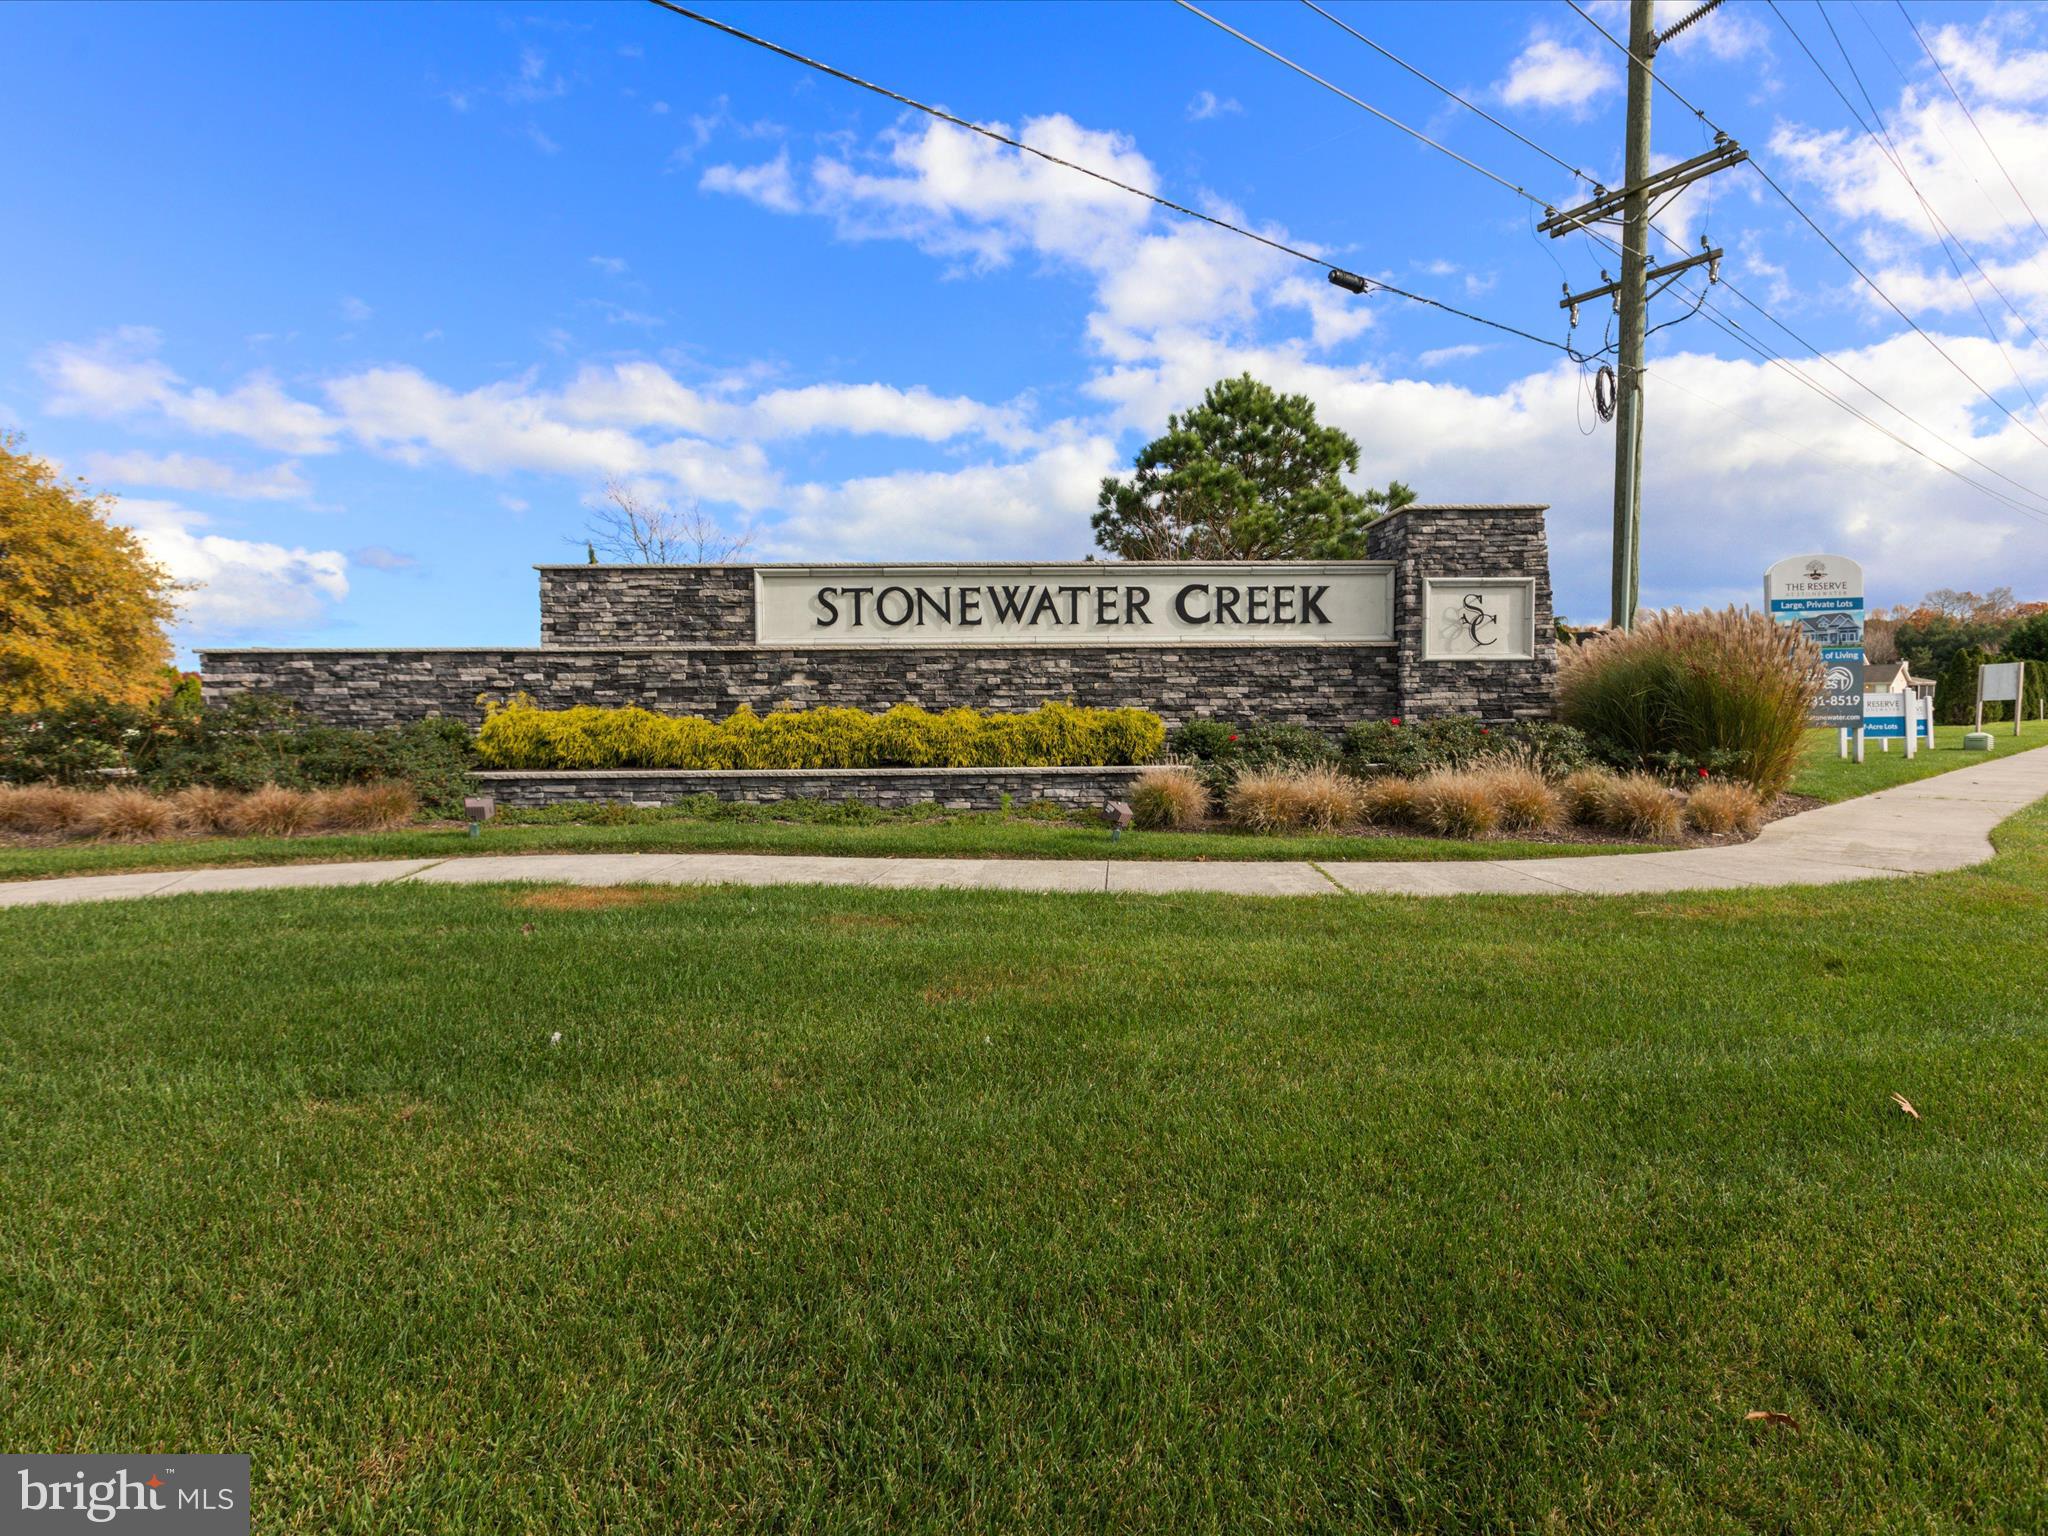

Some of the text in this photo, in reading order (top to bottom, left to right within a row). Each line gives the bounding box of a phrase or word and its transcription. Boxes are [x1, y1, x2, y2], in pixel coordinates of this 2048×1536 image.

[1785, 581, 1847, 591] THE RESERVE
[816, 584, 1333, 626] STONEWATER CREEK
[1806, 600, 1835, 609] Private
[1836, 600, 1854, 608] Lots
[1824, 652, 1833, 660] of
[1834, 651, 1859, 661] Living
[1866, 700, 1900, 708] RESERVE
